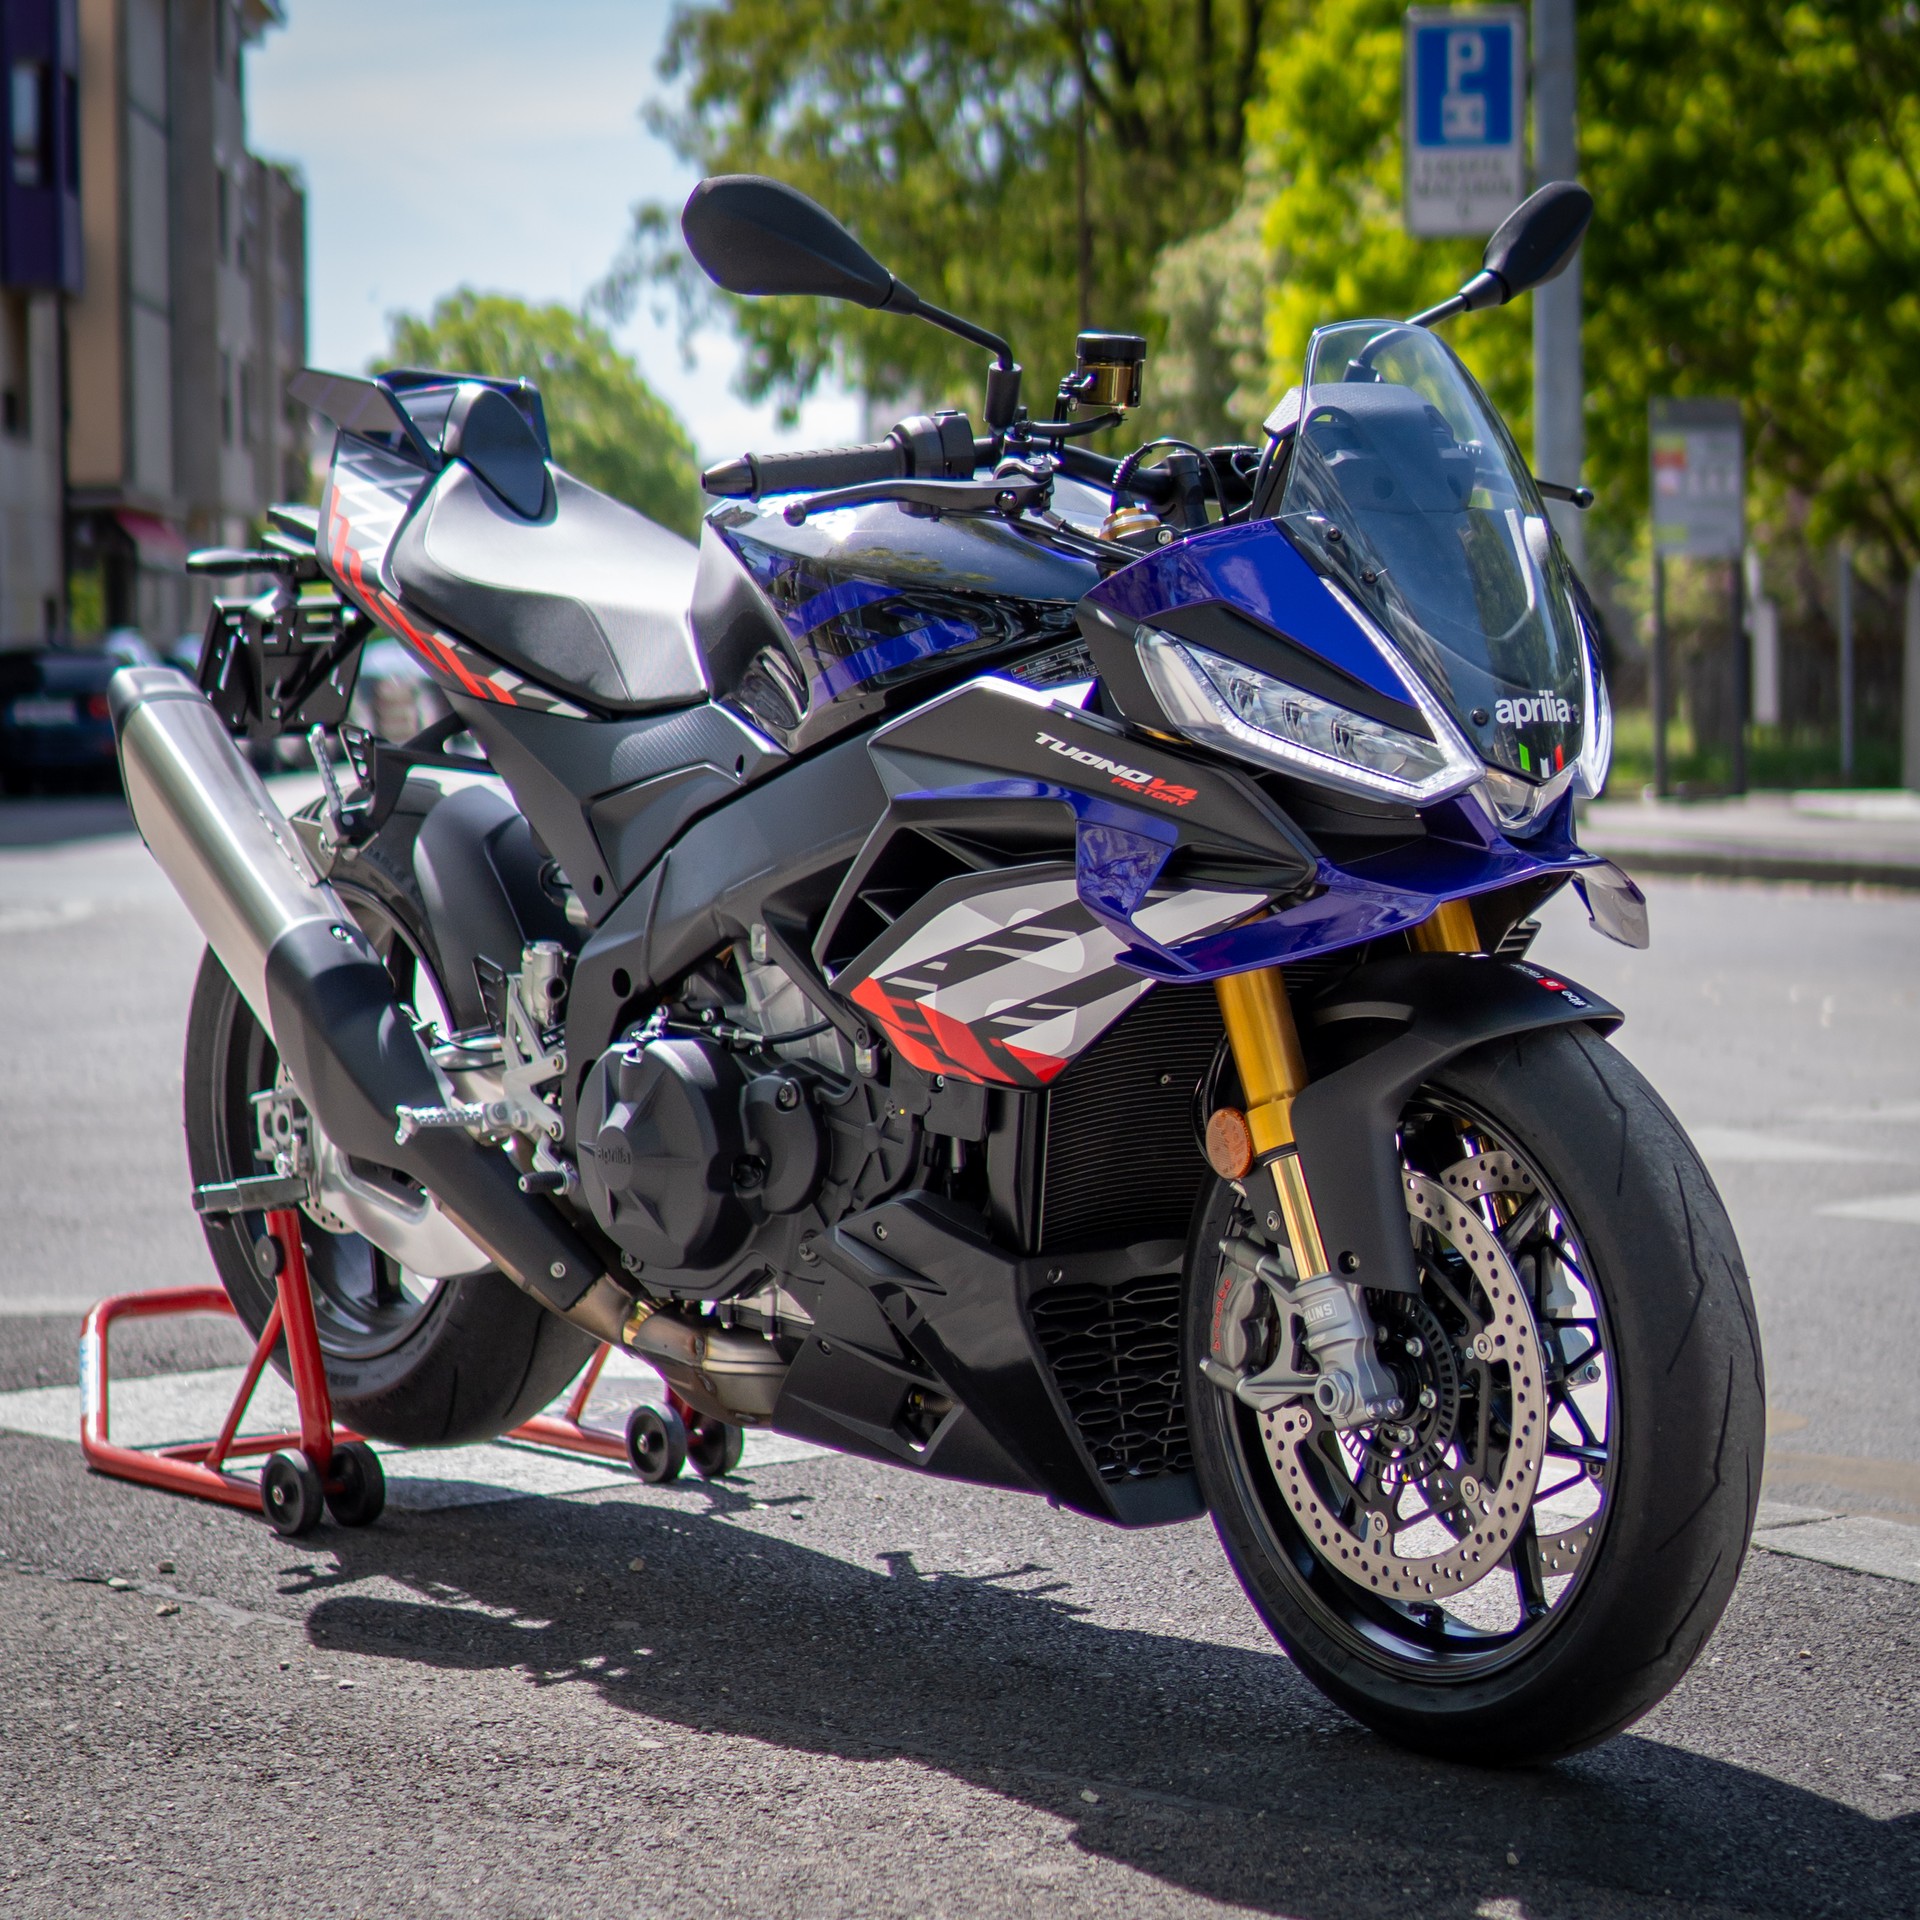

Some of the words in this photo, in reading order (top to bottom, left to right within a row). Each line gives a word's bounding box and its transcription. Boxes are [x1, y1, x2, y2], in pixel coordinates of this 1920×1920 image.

[1495, 689, 1571, 730] aprilia
[1034, 731, 1153, 784] TUONO
[1147, 777, 1199, 800] V4
[1110, 776, 1190, 807] FACTORY
[597, 1146, 632, 1166] aprilia
[1212, 1279, 1232, 1352] brembo
